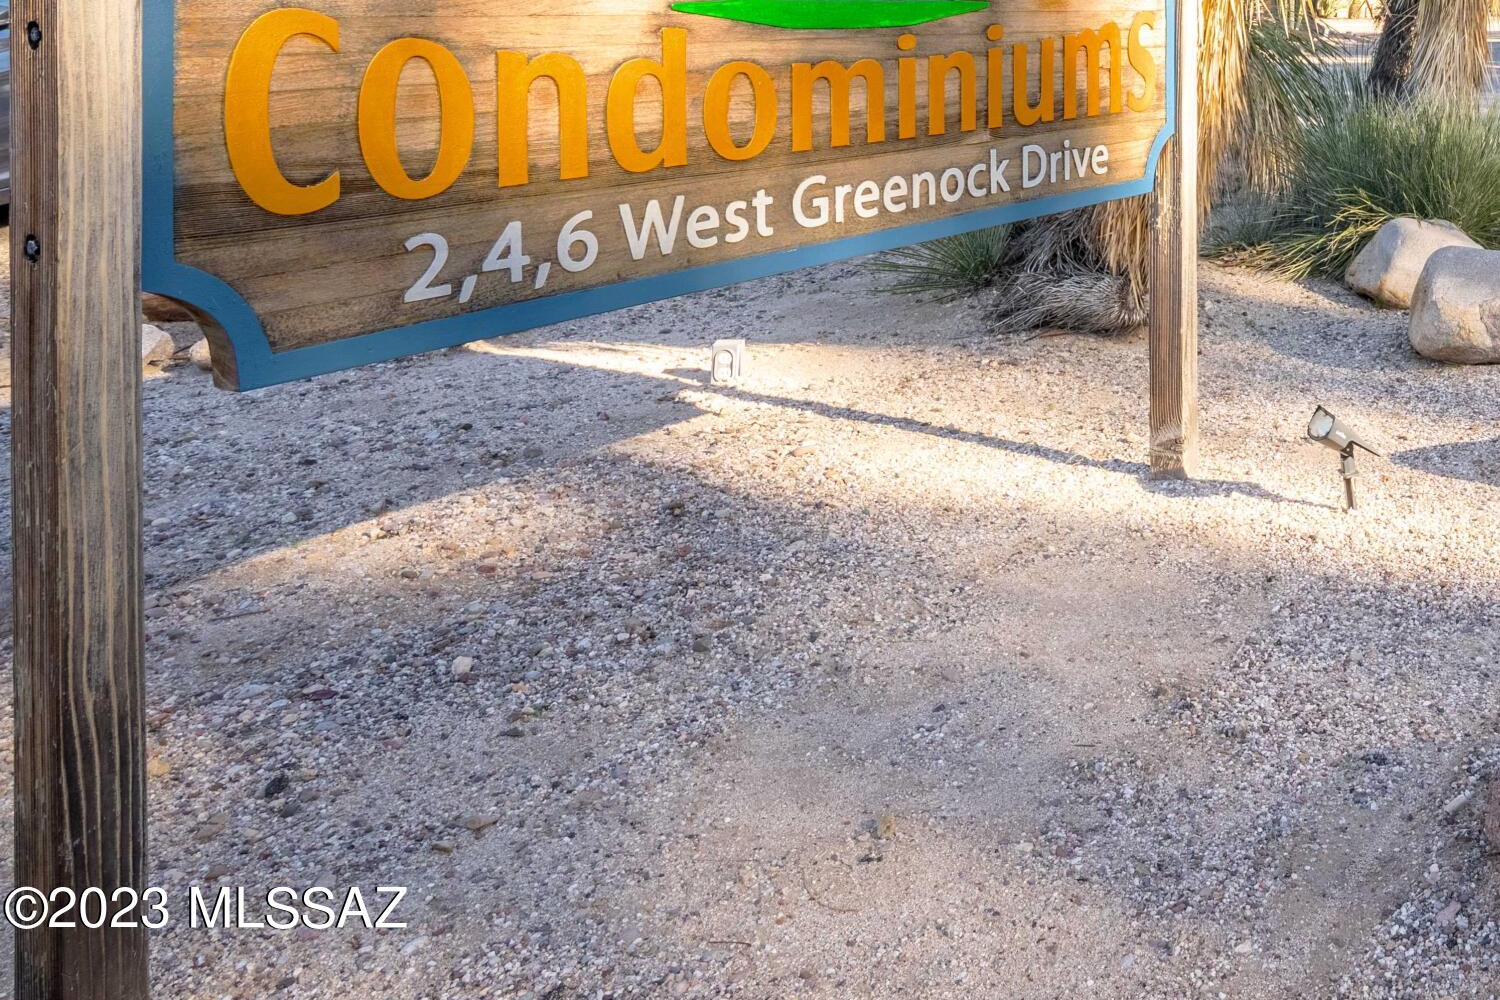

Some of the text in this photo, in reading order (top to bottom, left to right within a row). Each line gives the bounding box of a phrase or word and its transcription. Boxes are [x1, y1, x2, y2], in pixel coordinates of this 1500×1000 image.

[224, 8, 1158, 216] Condominiums
[404, 139, 1109, 303] 2,4,6 West Greenock Drive
